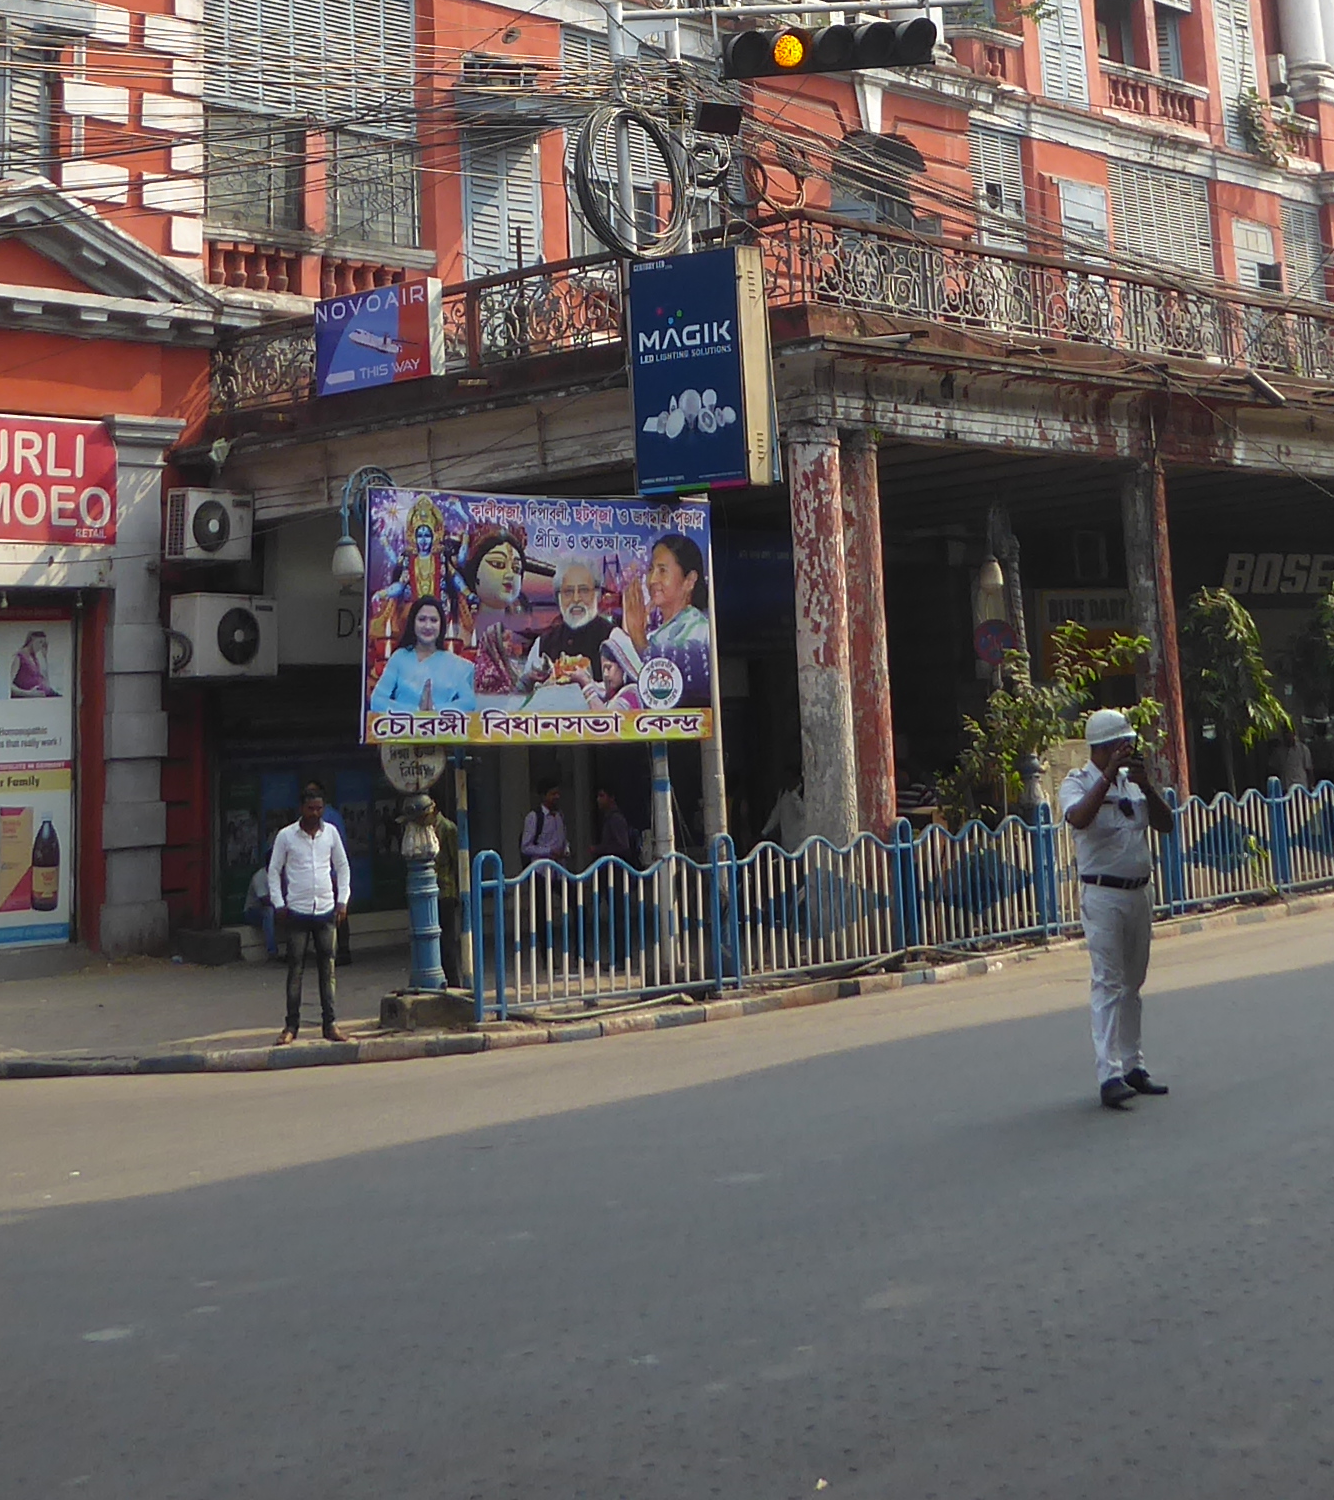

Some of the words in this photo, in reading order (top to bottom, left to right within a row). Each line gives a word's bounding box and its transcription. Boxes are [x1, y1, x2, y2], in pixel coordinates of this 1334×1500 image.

[315, 285, 425, 324] NOVOAIR
[638, 319, 732, 353] MAGIK
[640, 354, 655, 365] LED
[655, 349, 689, 363] LIGHTING
[691, 344, 732, 358] SOLUTIONS
[359, 364, 389, 380] THIS
[391, 358, 421, 373] WAY
[75, 528, 107, 539] RETAIL
[1048, 599, 1085, 623] BLUE
[373, 711, 469, 738] চৌরঙ্গী
[481, 709, 622, 739] বিধানসভা
[634, 712, 704, 736] কেন্দ্র
[7, 775, 41, 788] Family
